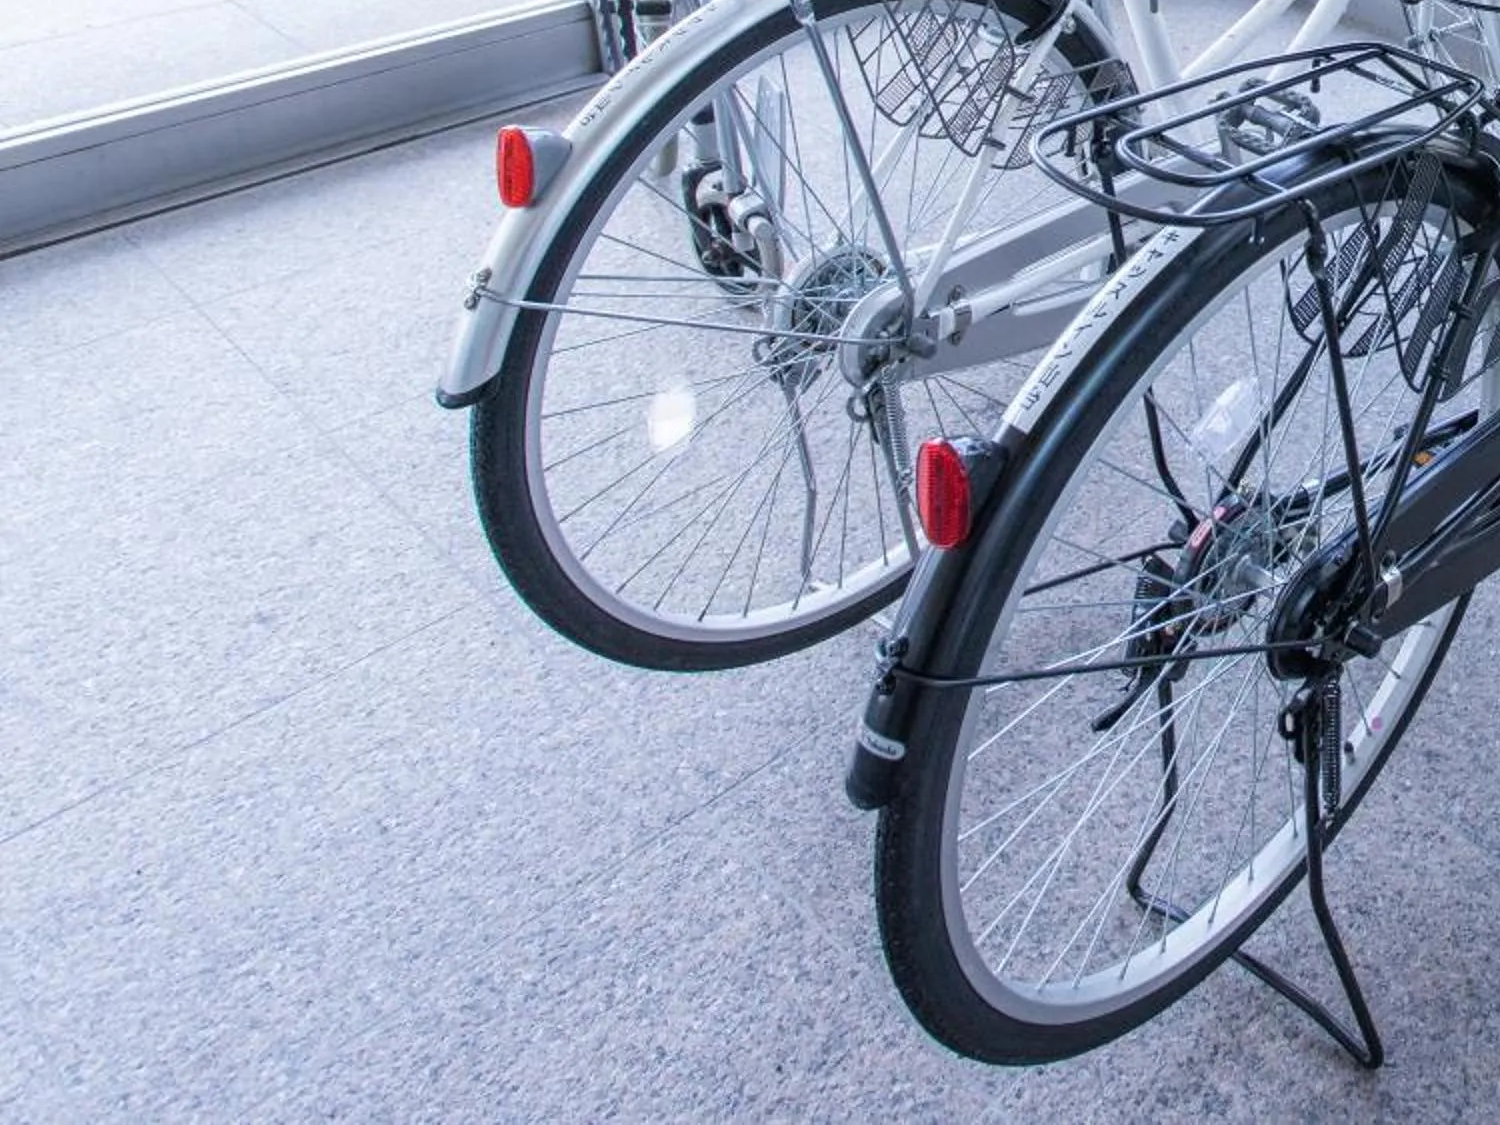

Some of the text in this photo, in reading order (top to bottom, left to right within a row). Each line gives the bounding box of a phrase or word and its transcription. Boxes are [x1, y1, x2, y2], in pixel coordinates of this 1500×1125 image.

[1021, 230, 1181, 411] キャッスルイン仙台
